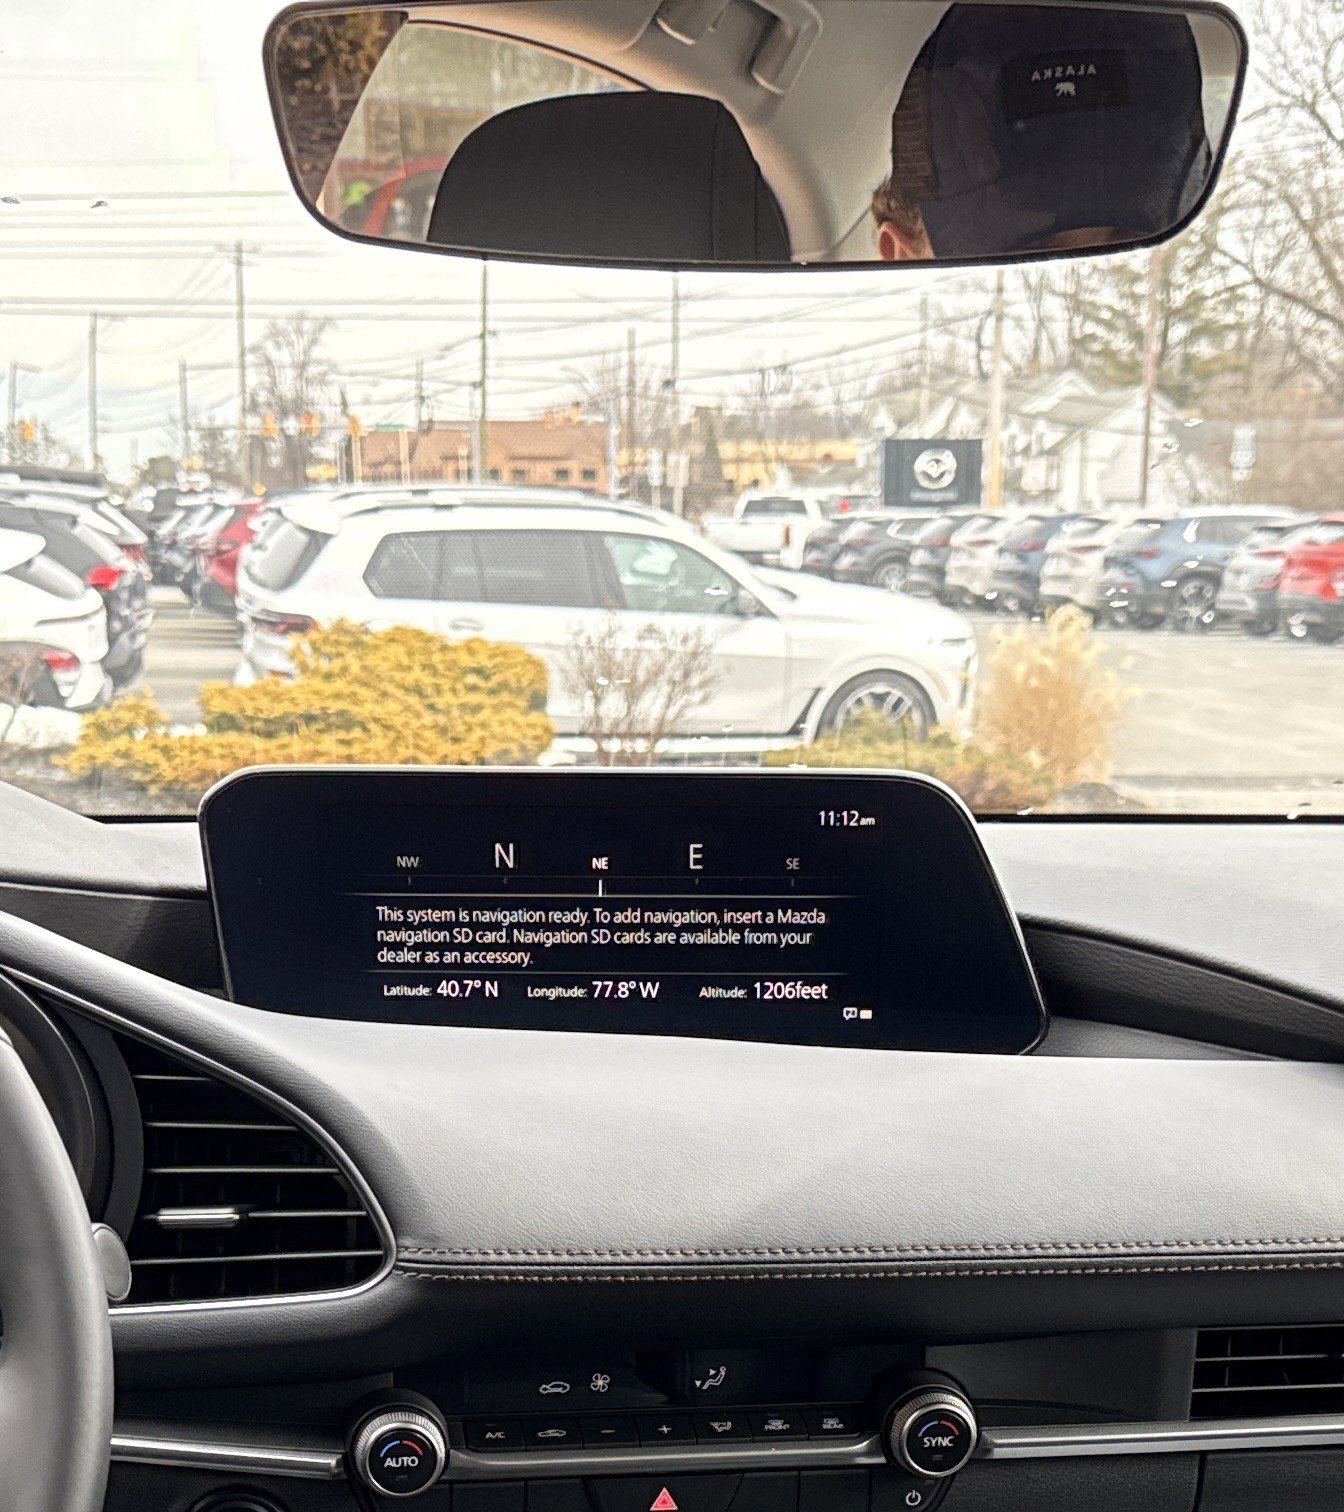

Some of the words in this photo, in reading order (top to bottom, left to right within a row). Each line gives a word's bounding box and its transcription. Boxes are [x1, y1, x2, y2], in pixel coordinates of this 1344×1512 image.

[397, 856, 420, 868] NW
[495, 843, 515, 869] N
[592, 857, 609, 870] NE
[689, 844, 703, 870] E
[786, 858, 800, 870] SE
[376, 906, 404, 922] This
[406, 909, 455, 925] system
[458, 908, 470, 922] is
[472, 908, 546, 926] navigation
[549, 908, 591, 926] ready.
[593, 908, 611, 923] To
[613, 908, 640, 924] add
[644, 909, 721, 927] navigation,
[723, 909, 762, 924] insert
[765, 912, 775, 924] a
[778, 908, 826, 924] Mazda
[377, 927, 450, 946] navigation
[453, 928, 473, 943] SD
[476, 928, 510, 943] card.
[514, 929, 588, 947] Navigation
[591, 929, 611, 943] SD
[613, 929, 651, 944] cards
[654, 932, 676, 944] are
[679, 928, 741, 944] available
[744, 929, 778, 944] from
[780, 933, 812, 948] your
[377, 948, 421, 963] dealer
[425, 952, 439, 963] as
[443, 952, 460, 963] an
[463, 952, 534, 967] accessory.
[383, 985, 432, 997] Latitude:
[485, 980, 498, 997] N
[527, 986, 588, 1000] Longitude:
[639, 982, 660, 998] W
[699, 986, 747, 998] Altitude:
[754, 981, 828, 999] 1206feet
[922, 1435, 954, 1449] SYNC
[384, 1455, 419, 1469] AUTO
